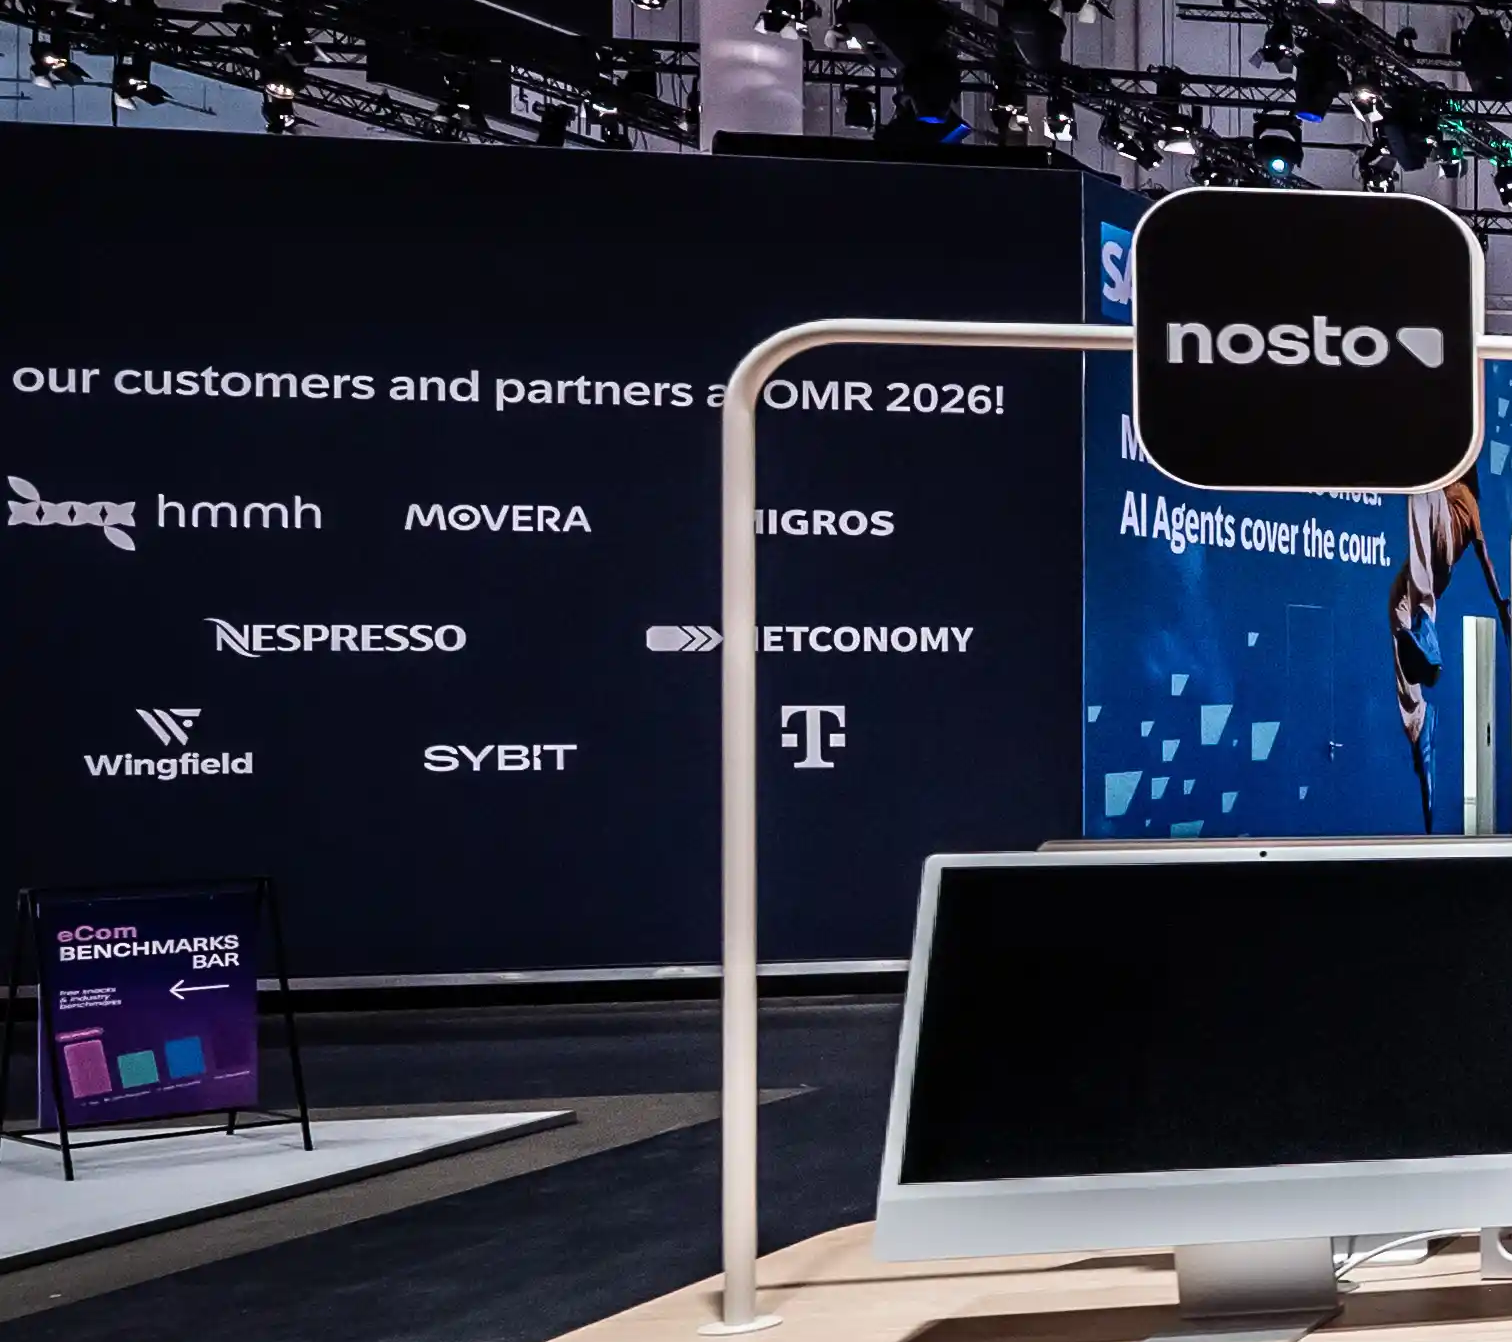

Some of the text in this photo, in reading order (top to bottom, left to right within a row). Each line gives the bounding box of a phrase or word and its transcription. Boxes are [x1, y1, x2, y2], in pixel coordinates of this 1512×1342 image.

[1167, 315, 1390, 367] nosto
[12, 364, 1006, 415] our customers and partners a OMR 2026!
[157, 493, 323, 531] hmmh
[404, 503, 593, 534] MOVERA
[1120, 490, 1391, 567] AI Agents cover the court.
[205, 617, 468, 658] NESPRESSO
[754, 625, 974, 653] ETCONOMY
[83, 749, 254, 782] Wingfield
[423, 744, 578, 773] SYBIT
[57, 925, 138, 943] eCom
[60, 935, 240, 962] BENCHMARKS
[192, 951, 240, 969] BAR
